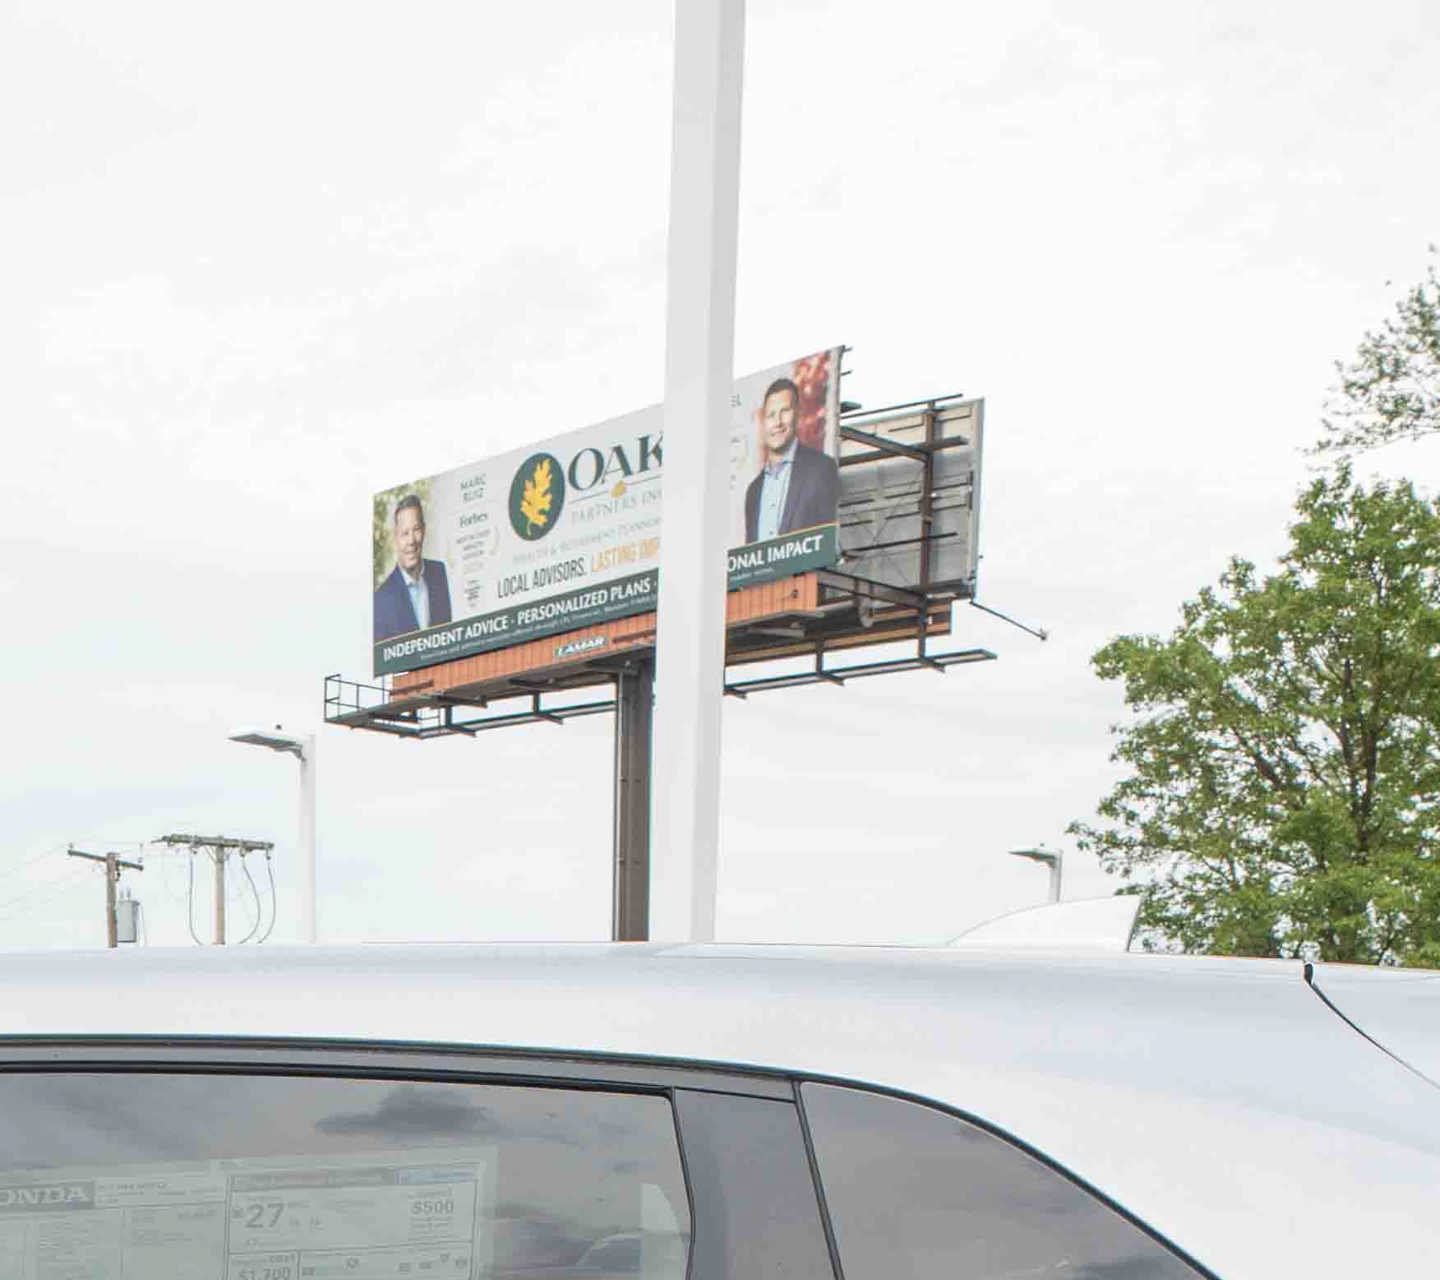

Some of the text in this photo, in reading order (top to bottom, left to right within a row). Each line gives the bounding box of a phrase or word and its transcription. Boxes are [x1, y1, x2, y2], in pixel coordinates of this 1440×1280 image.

[459, 512, 488, 528] Forbes
[497, 572, 530, 599] LOCAL
[532, 556, 587, 588] ADVISORS.
[383, 534, 824, 662] INDEPENDENT ADVICE PERSONALIZED PLANS ONAL IMPACT
[558, 636, 606, 657] LAMAR
[245, 1203, 285, 1229] 27
[411, 1199, 455, 1215] $500
